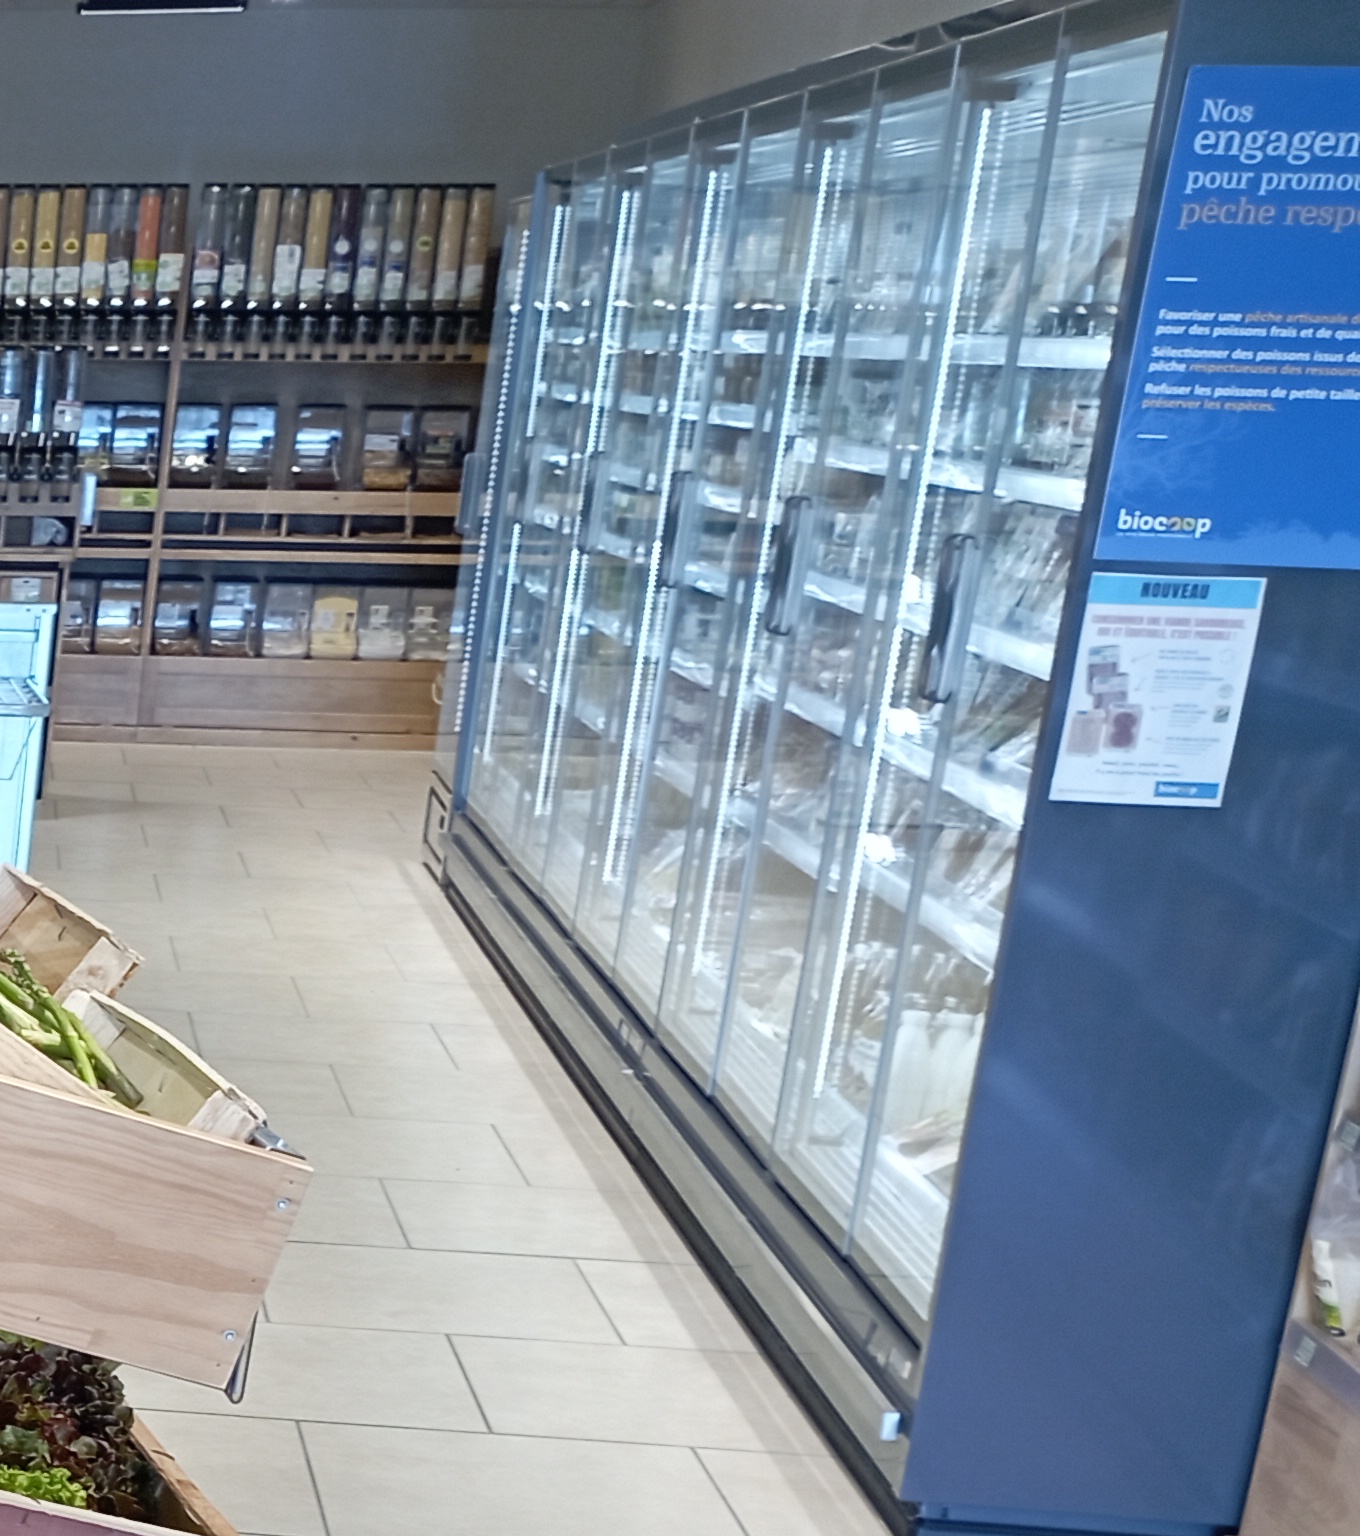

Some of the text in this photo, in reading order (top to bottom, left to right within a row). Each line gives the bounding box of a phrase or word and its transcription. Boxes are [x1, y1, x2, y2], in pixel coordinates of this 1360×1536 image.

[1199, 99, 1254, 123] Nos
[1184, 170, 1254, 194] pour
[1177, 197, 1276, 230] pêche
[1218, 311, 1242, 321] une
[1155, 325, 1186, 336] pour
[1188, 324, 1210, 335] des
[1212, 326, 1267, 337] poissons
[1270, 326, 1297, 338] frais
[1299, 326, 1313, 338] et
[1315, 327, 1332, 338] de
[1231, 348, 1254, 360] des
[1256, 350, 1310, 362] poissons
[1313, 350, 1344, 362] issus
[1144, 382, 1192, 395] Refuser
[1194, 384, 1212, 396] les
[1213, 386, 1268, 398] poissons
[1270, 387, 1287, 398] de
[1289, 388, 1328, 400] petite
[1117, 508, 1212, 538] biocoop
[1140, 581, 1210, 600] NOUVEAU
